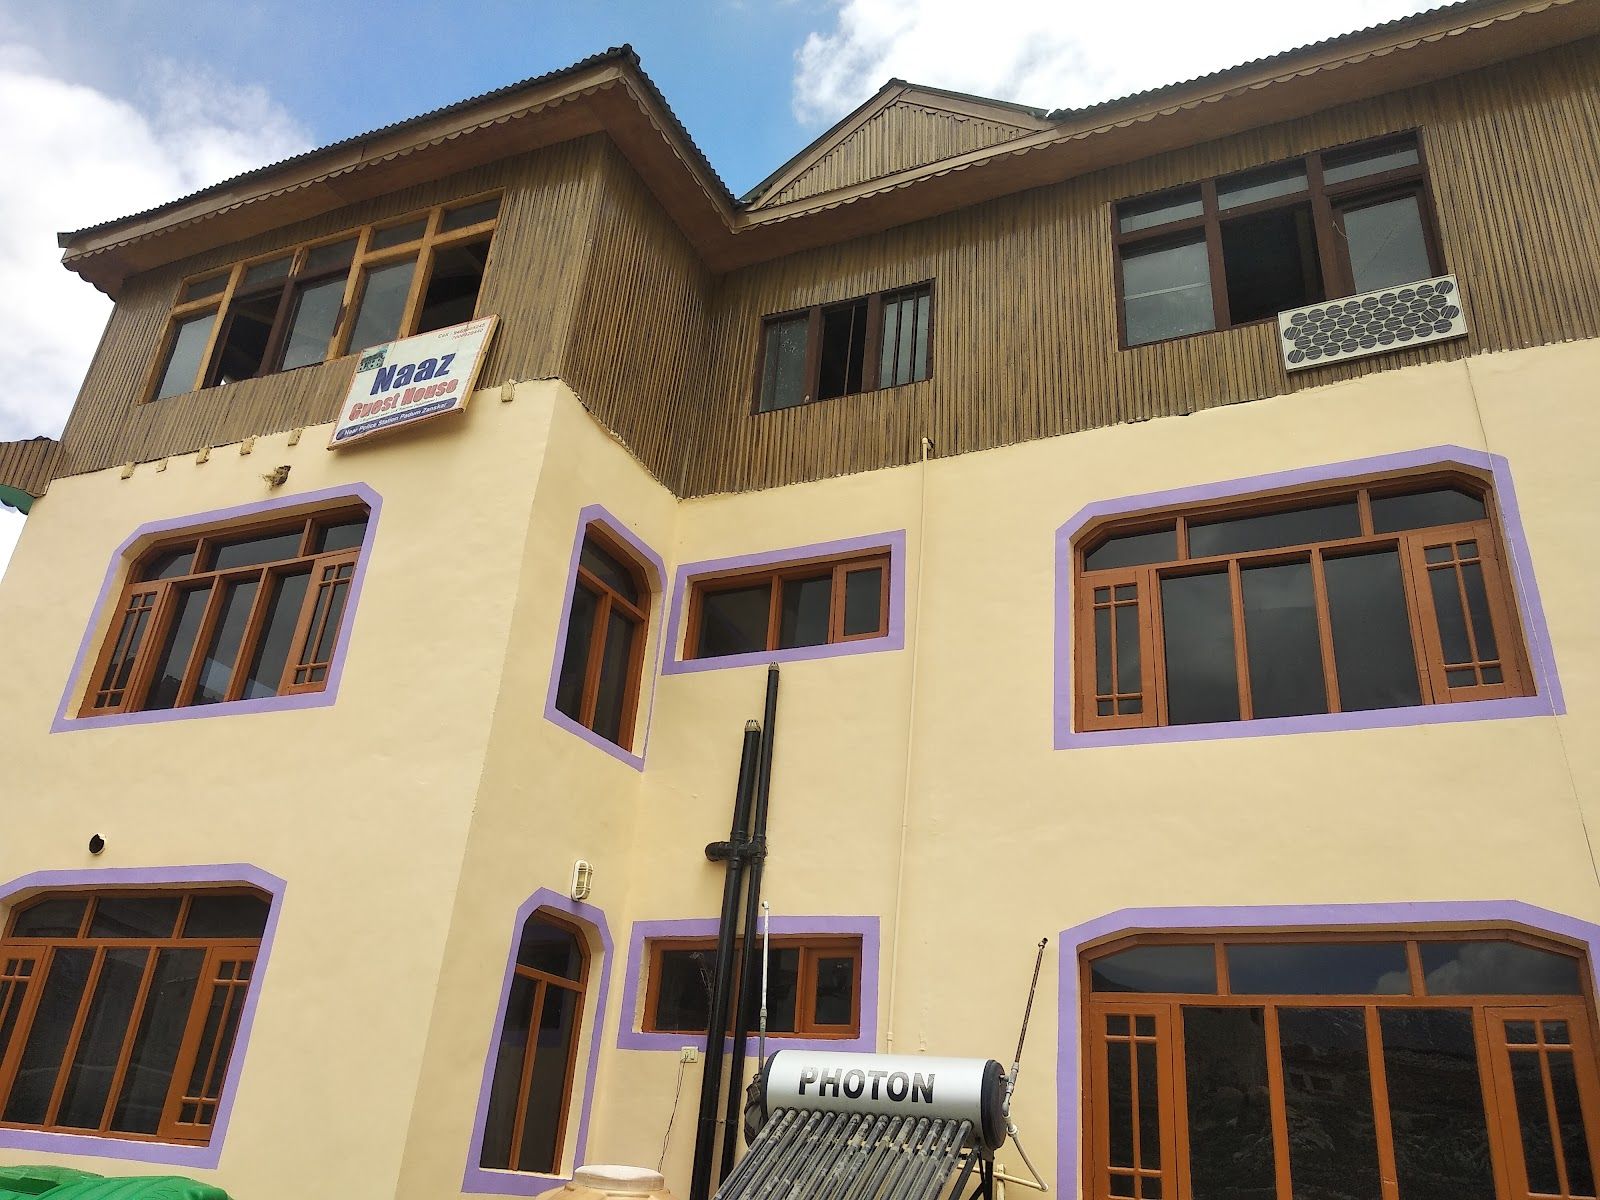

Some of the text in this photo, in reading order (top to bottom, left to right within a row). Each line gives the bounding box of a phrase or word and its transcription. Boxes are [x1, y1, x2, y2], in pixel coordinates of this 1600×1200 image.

[370, 353, 457, 396] Naaz
[343, 427, 359, 436] Near
[358, 422, 377, 432] Police
[378, 416, 399, 426] Station
[399, 410, 421, 420] Padum
[421, 402, 448, 414] Zanskar
[348, 393, 401, 422] Guest
[401, 379, 459, 407] House
[798, 1066, 936, 1104] PHOTON
